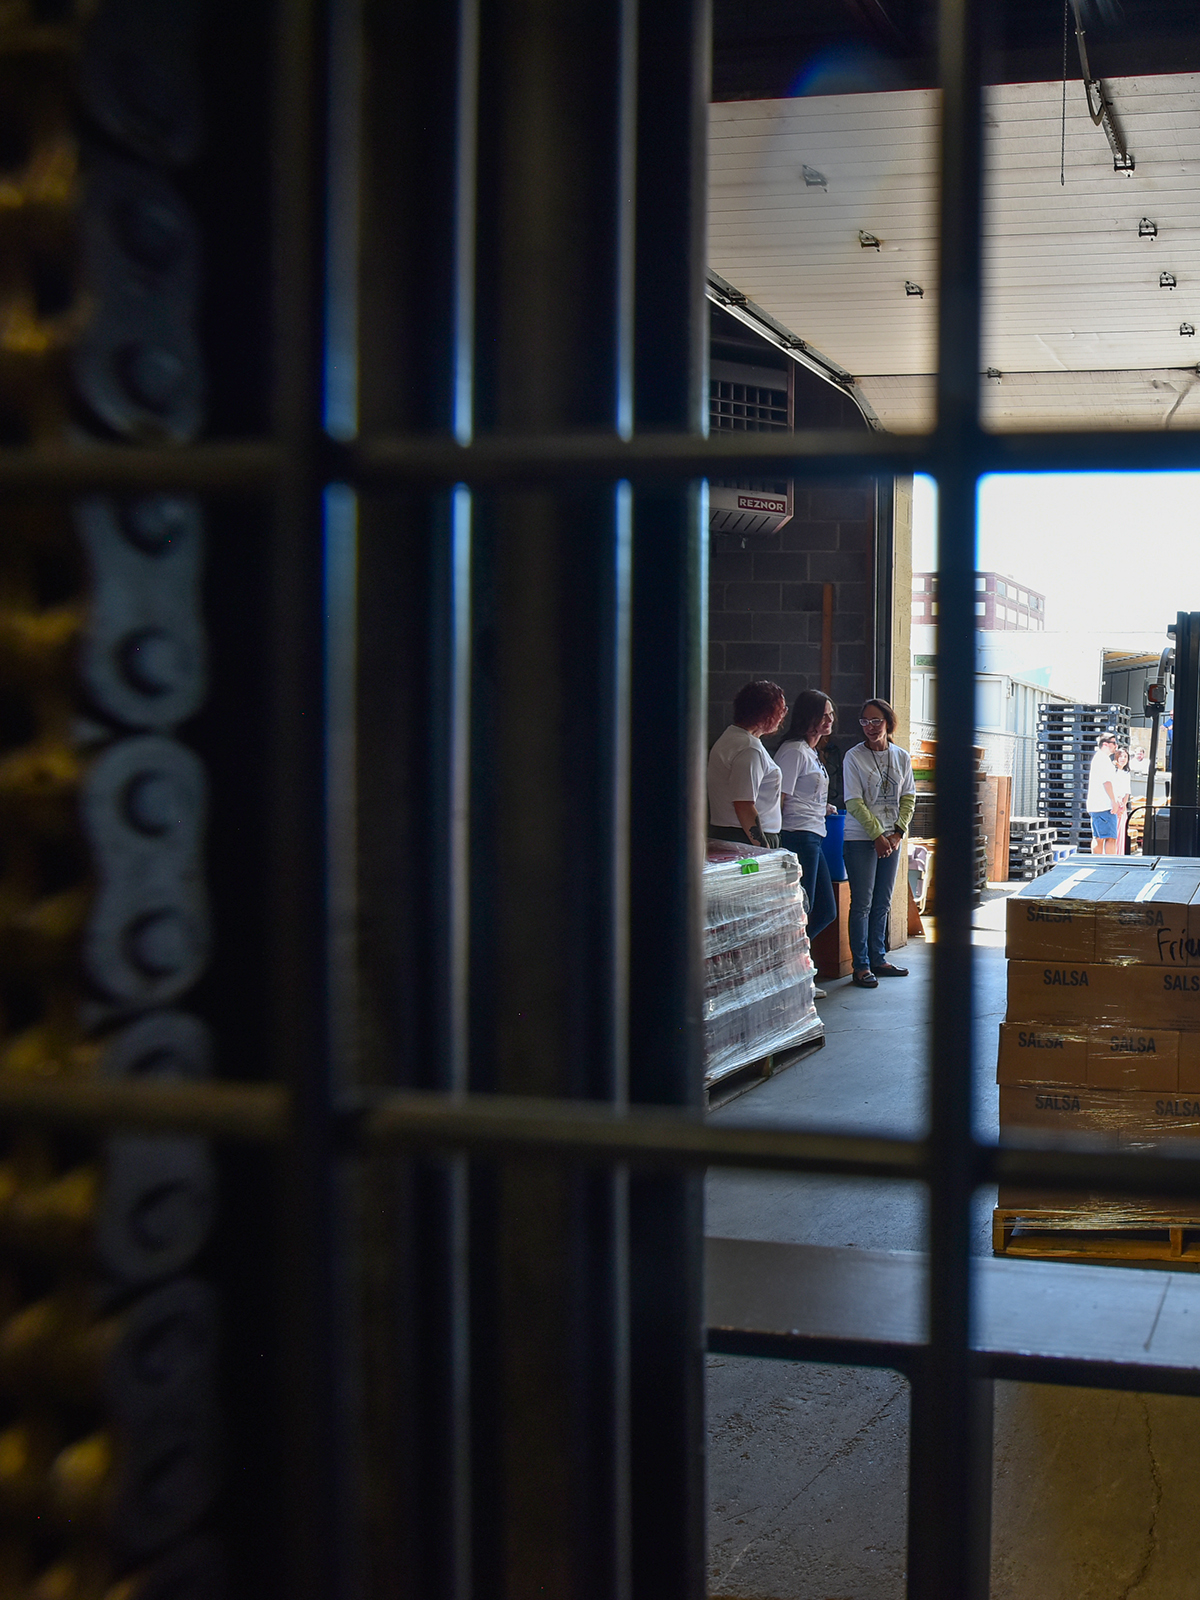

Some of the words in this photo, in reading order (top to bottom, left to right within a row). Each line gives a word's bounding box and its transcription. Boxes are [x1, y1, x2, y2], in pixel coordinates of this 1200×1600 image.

[739, 497, 785, 512] REZNOR
[1026, 905, 1073, 923] SALSA
[1043, 969, 1089, 987] SALSA
[1018, 1031, 1064, 1049] SALSA
[1110, 1035, 1156, 1053] SALSA
[1035, 1094, 1081, 1112] SALSA
